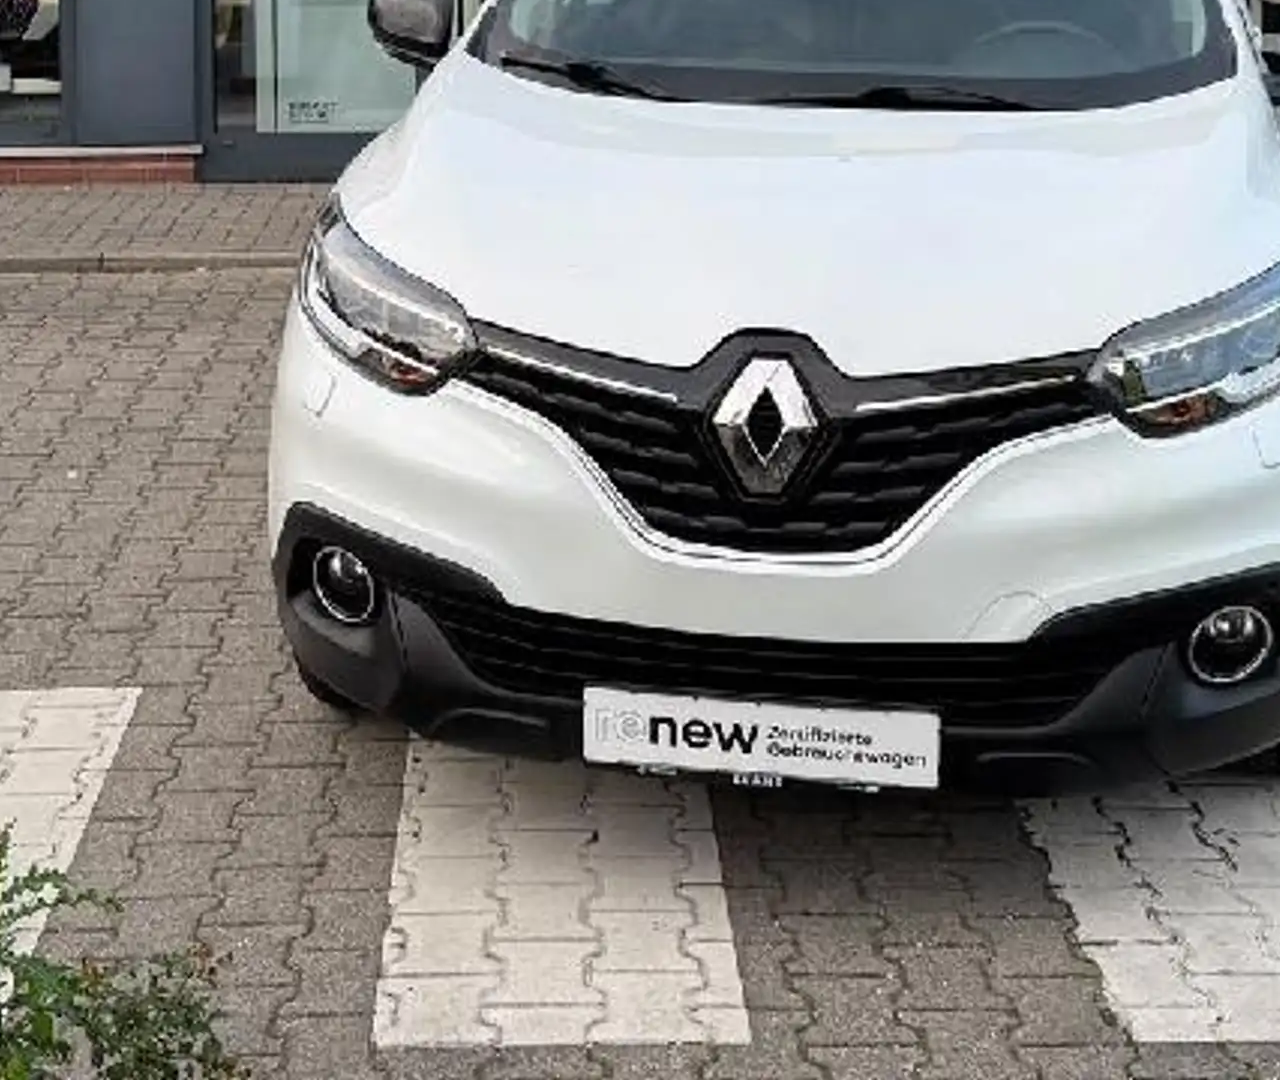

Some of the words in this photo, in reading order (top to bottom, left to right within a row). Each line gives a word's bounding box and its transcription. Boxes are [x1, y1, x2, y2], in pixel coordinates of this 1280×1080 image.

[594, 708, 758, 755] renew
[766, 725, 873, 746] Zertifizierte
[766, 741, 927, 769] Gebrauchswagen
